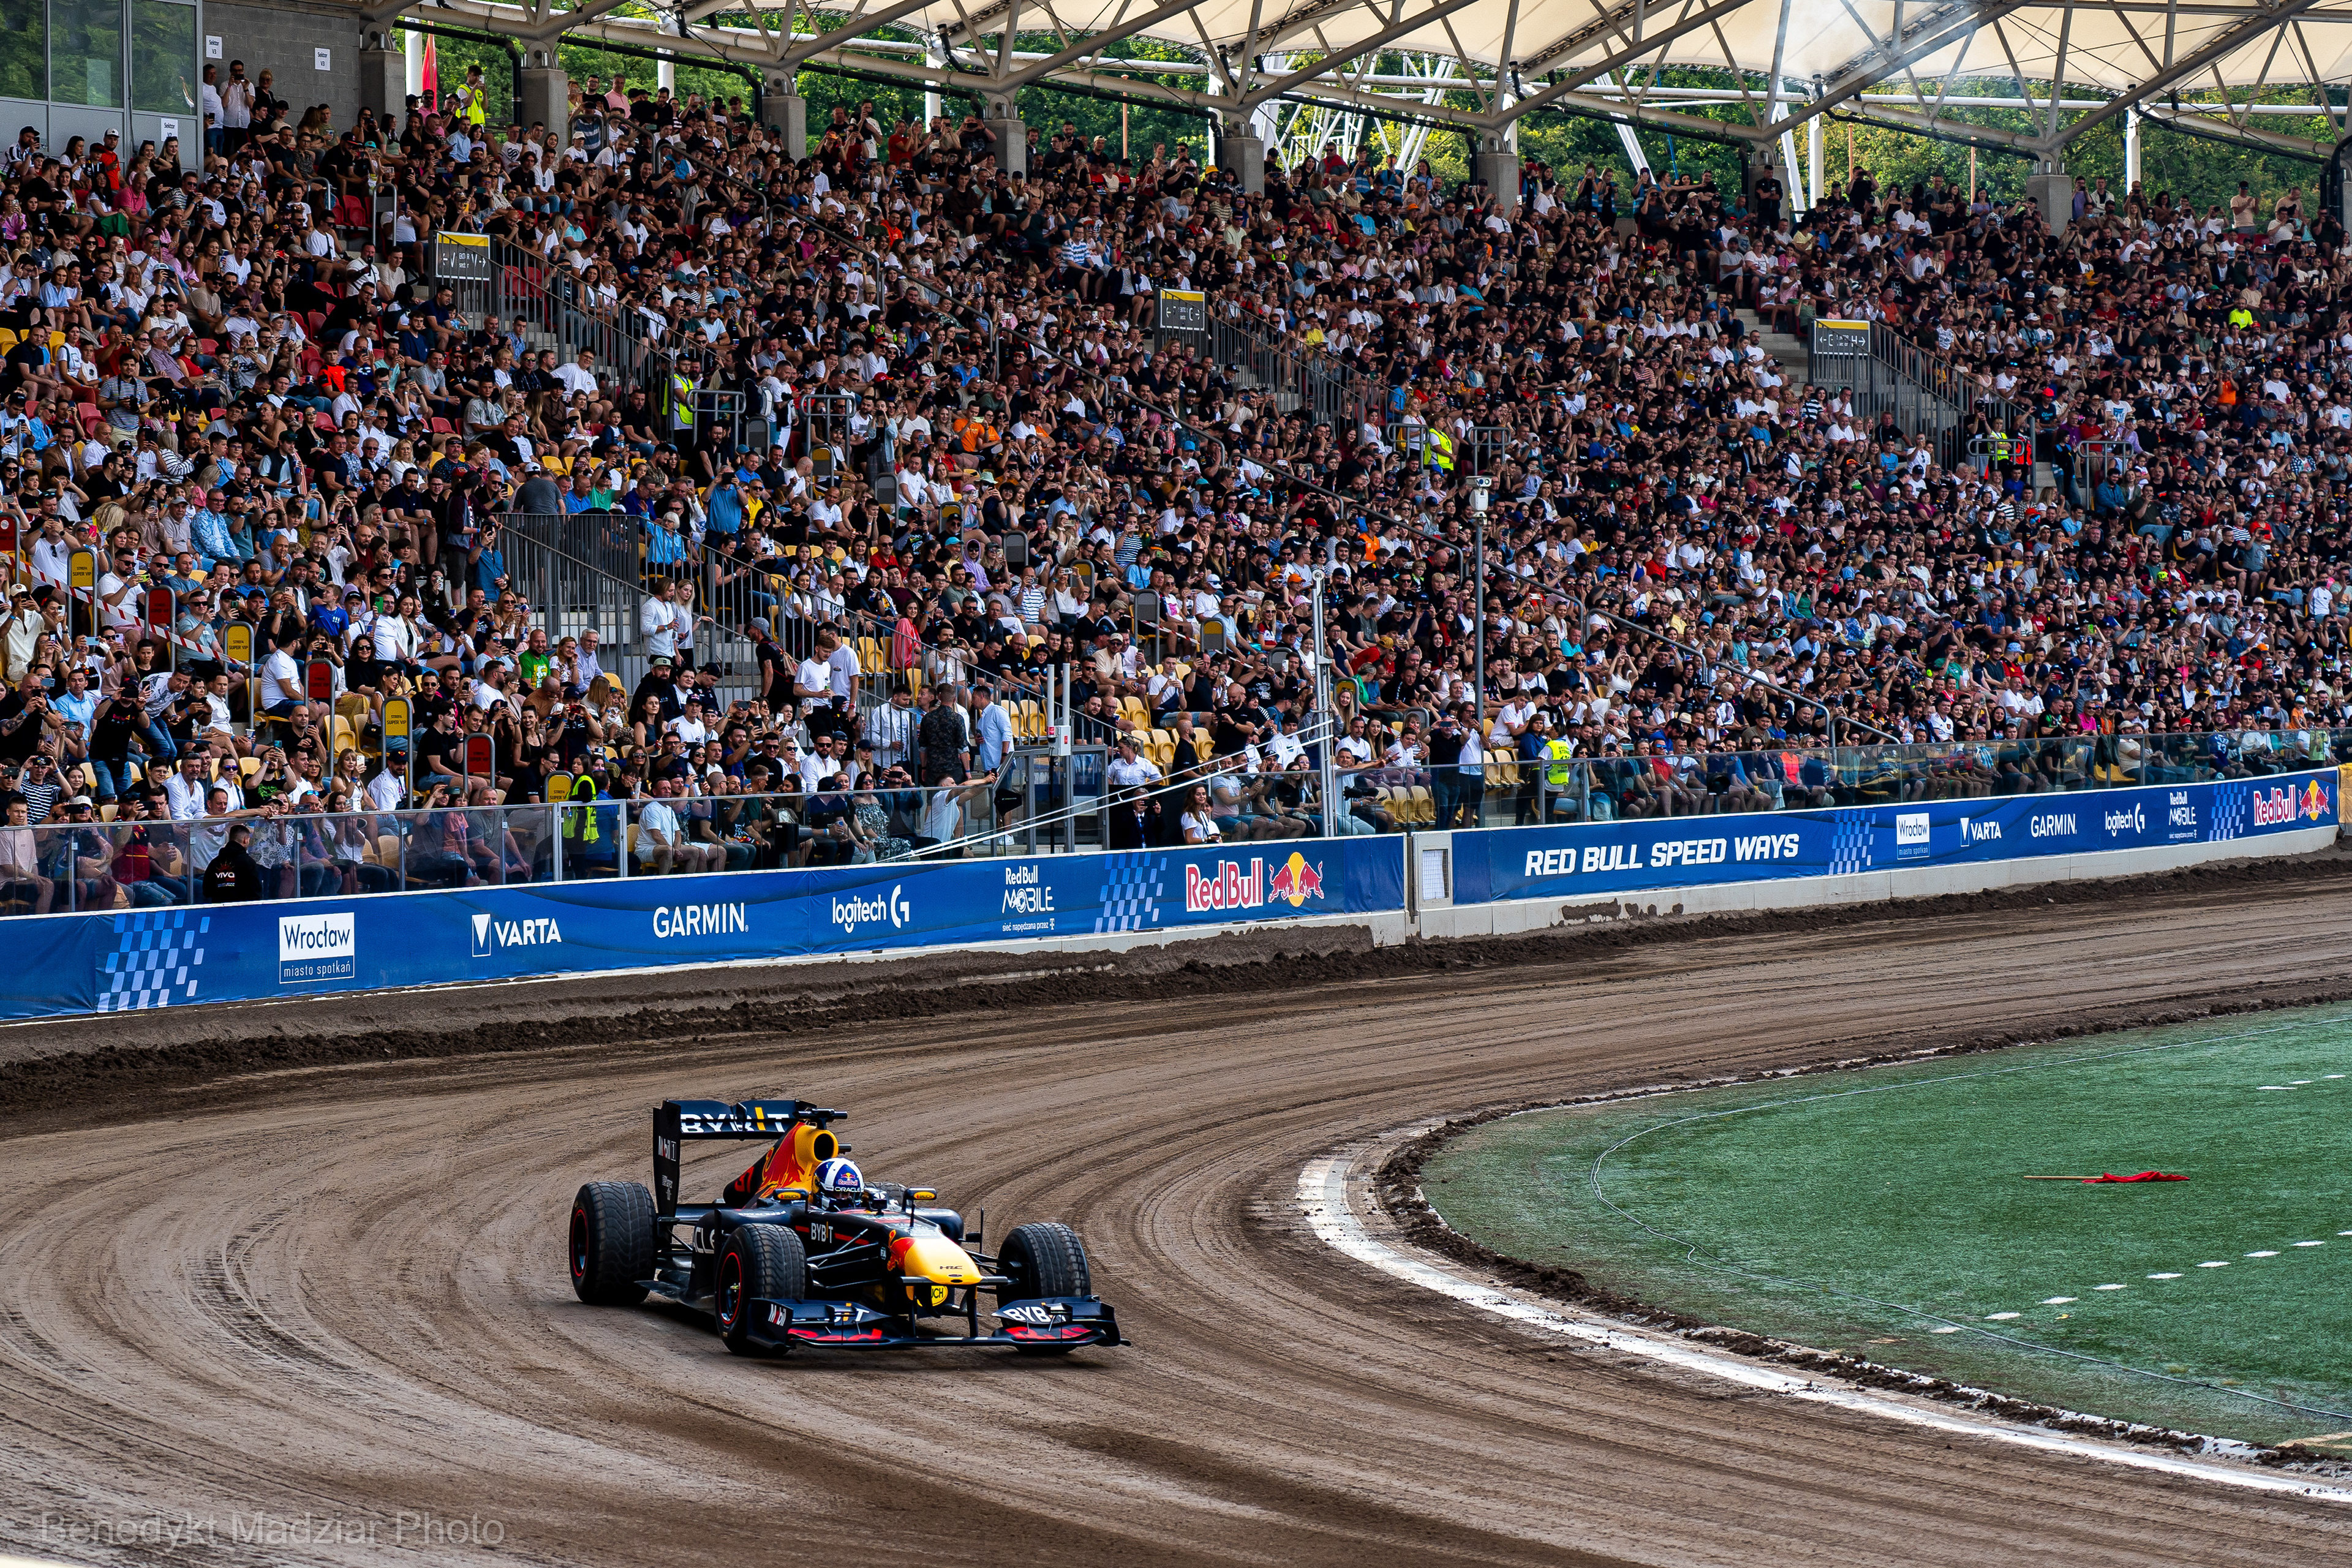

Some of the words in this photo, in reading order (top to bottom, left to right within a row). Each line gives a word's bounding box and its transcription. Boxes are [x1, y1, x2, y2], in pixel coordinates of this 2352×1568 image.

[2170, 792, 2179, 805] Red
[2179, 791, 2187, 804] Bull
[2254, 788, 2275, 826] Red
[2276, 785, 2296, 823] Bull
[1899, 818, 1928, 837] Wrocław
[2031, 813, 2076, 837] GARMIN
[2105, 809, 2133, 837] logitech
[2169, 807, 2196, 826] MOBILE
[1970, 821, 2002, 840] VARTA
[1525, 848, 1577, 876] RED
[1582, 844, 1643, 872] BULL
[1650, 838, 1727, 867] SPEED
[1735, 834, 1800, 861] WAYS
[1899, 846, 1912, 855] miasto
[1006, 865, 1022, 885] Red
[1022, 865, 1038, 884] Bull
[1186, 861, 1224, 911] Red
[1226, 858, 1263, 909] Bull
[1002, 886, 1055, 913] MOBILE
[653, 902, 745, 938] GARMIN
[832, 894, 886, 933] logitech
[284, 921, 350, 950] Wrocław
[494, 918, 562, 948] VARTA
[1002, 922, 1011, 932] sieć
[1037, 922, 1049, 930] przez
[284, 965, 313, 977] miasto
[317, 960, 350, 978] spotkań
[811, 1221, 833, 1243] BYBIT
[768, 1303, 786, 1327] Mobil
